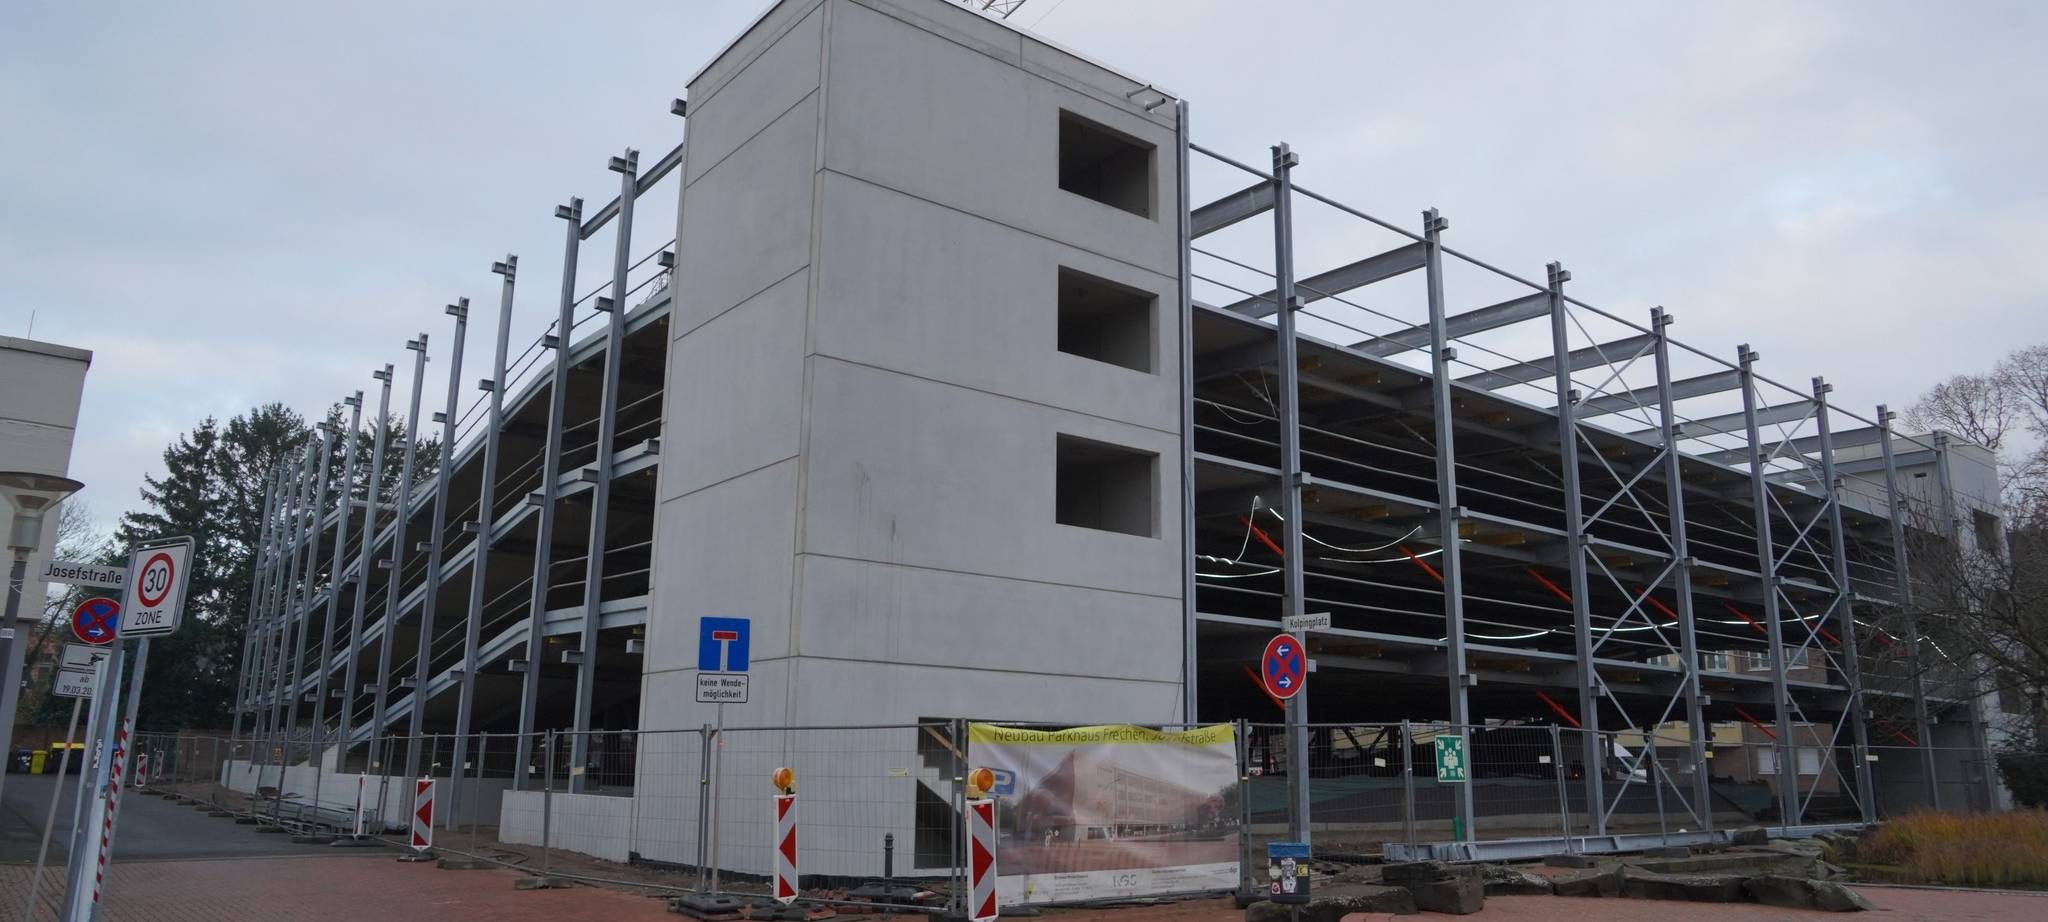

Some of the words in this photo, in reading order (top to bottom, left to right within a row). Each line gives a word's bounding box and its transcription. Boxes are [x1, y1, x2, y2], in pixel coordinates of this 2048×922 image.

[45, 563, 122, 585] Josefstraße
[145, 567, 168, 593] 30
[135, 609, 162, 626] ZONE
[1290, 616, 1328, 631] Kolpingplatz
[700, 678, 718, 687] keine
[721, 678, 746, 687] Wende-
[63, 685, 95, 696] 19.03.20
[703, 689, 741, 700] möglichkeit
[994, 729, 1044, 742] Neubau
[1048, 730, 1099, 742] Parkhaus
[1103, 728, 1148, 741] Frechen,
